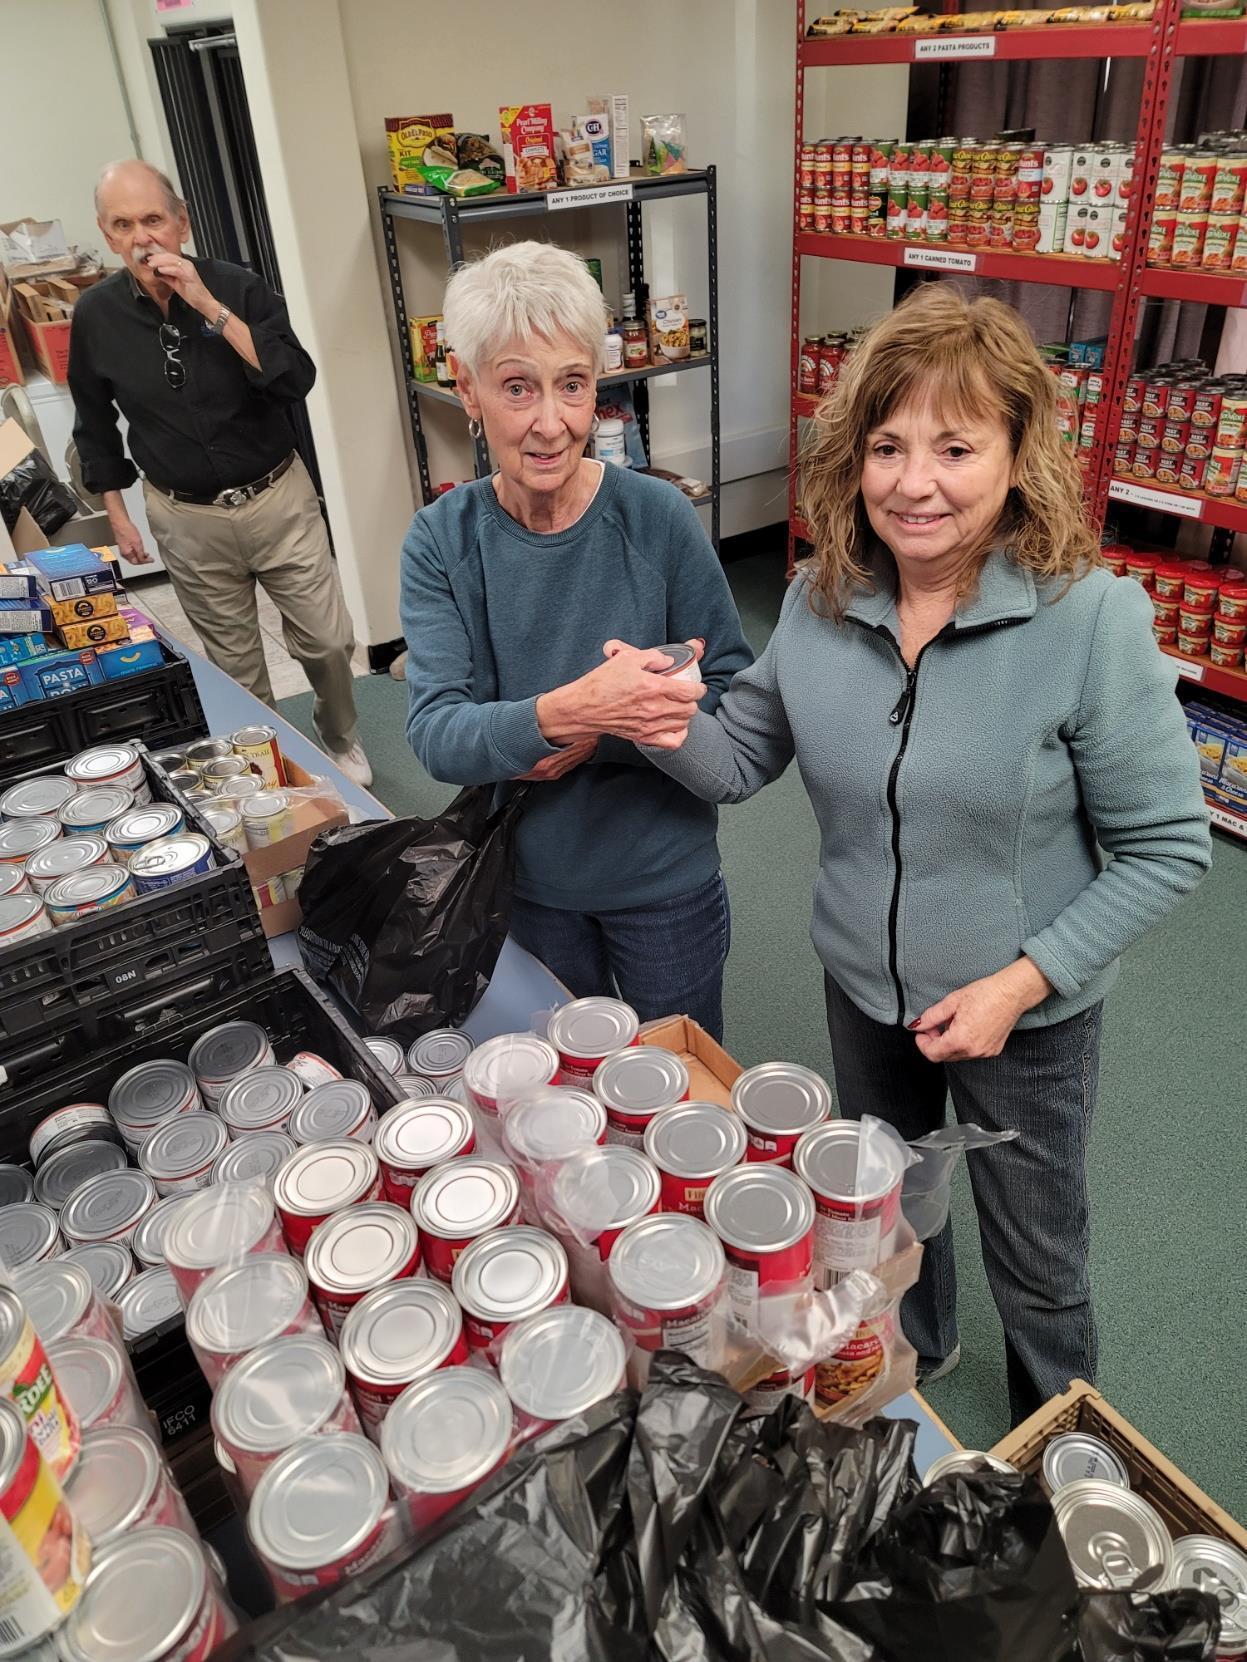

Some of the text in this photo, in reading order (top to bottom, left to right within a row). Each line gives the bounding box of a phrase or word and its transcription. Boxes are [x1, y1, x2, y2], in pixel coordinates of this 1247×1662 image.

[920, 44, 931, 52] ANY
[938, 43, 956, 51] PASTA
[957, 42, 990, 50] PRODUCTS
[593, 148, 607, 157] GAR
[570, 193, 598, 202] PRODUCT
[608, 189, 629, 197] CHOICE
[924, 255, 947, 264] CANNED
[948, 257, 972, 267] TOMATO
[1110, 485, 1123, 494] ANY
[42, 668, 84, 685] PASTA
[1221, 816, 1237, 827] MAC
[115, 970, 137, 984] 08N
[162, 1405, 195, 1429] IFCO
[167, 1413, 196, 1436] 6411
